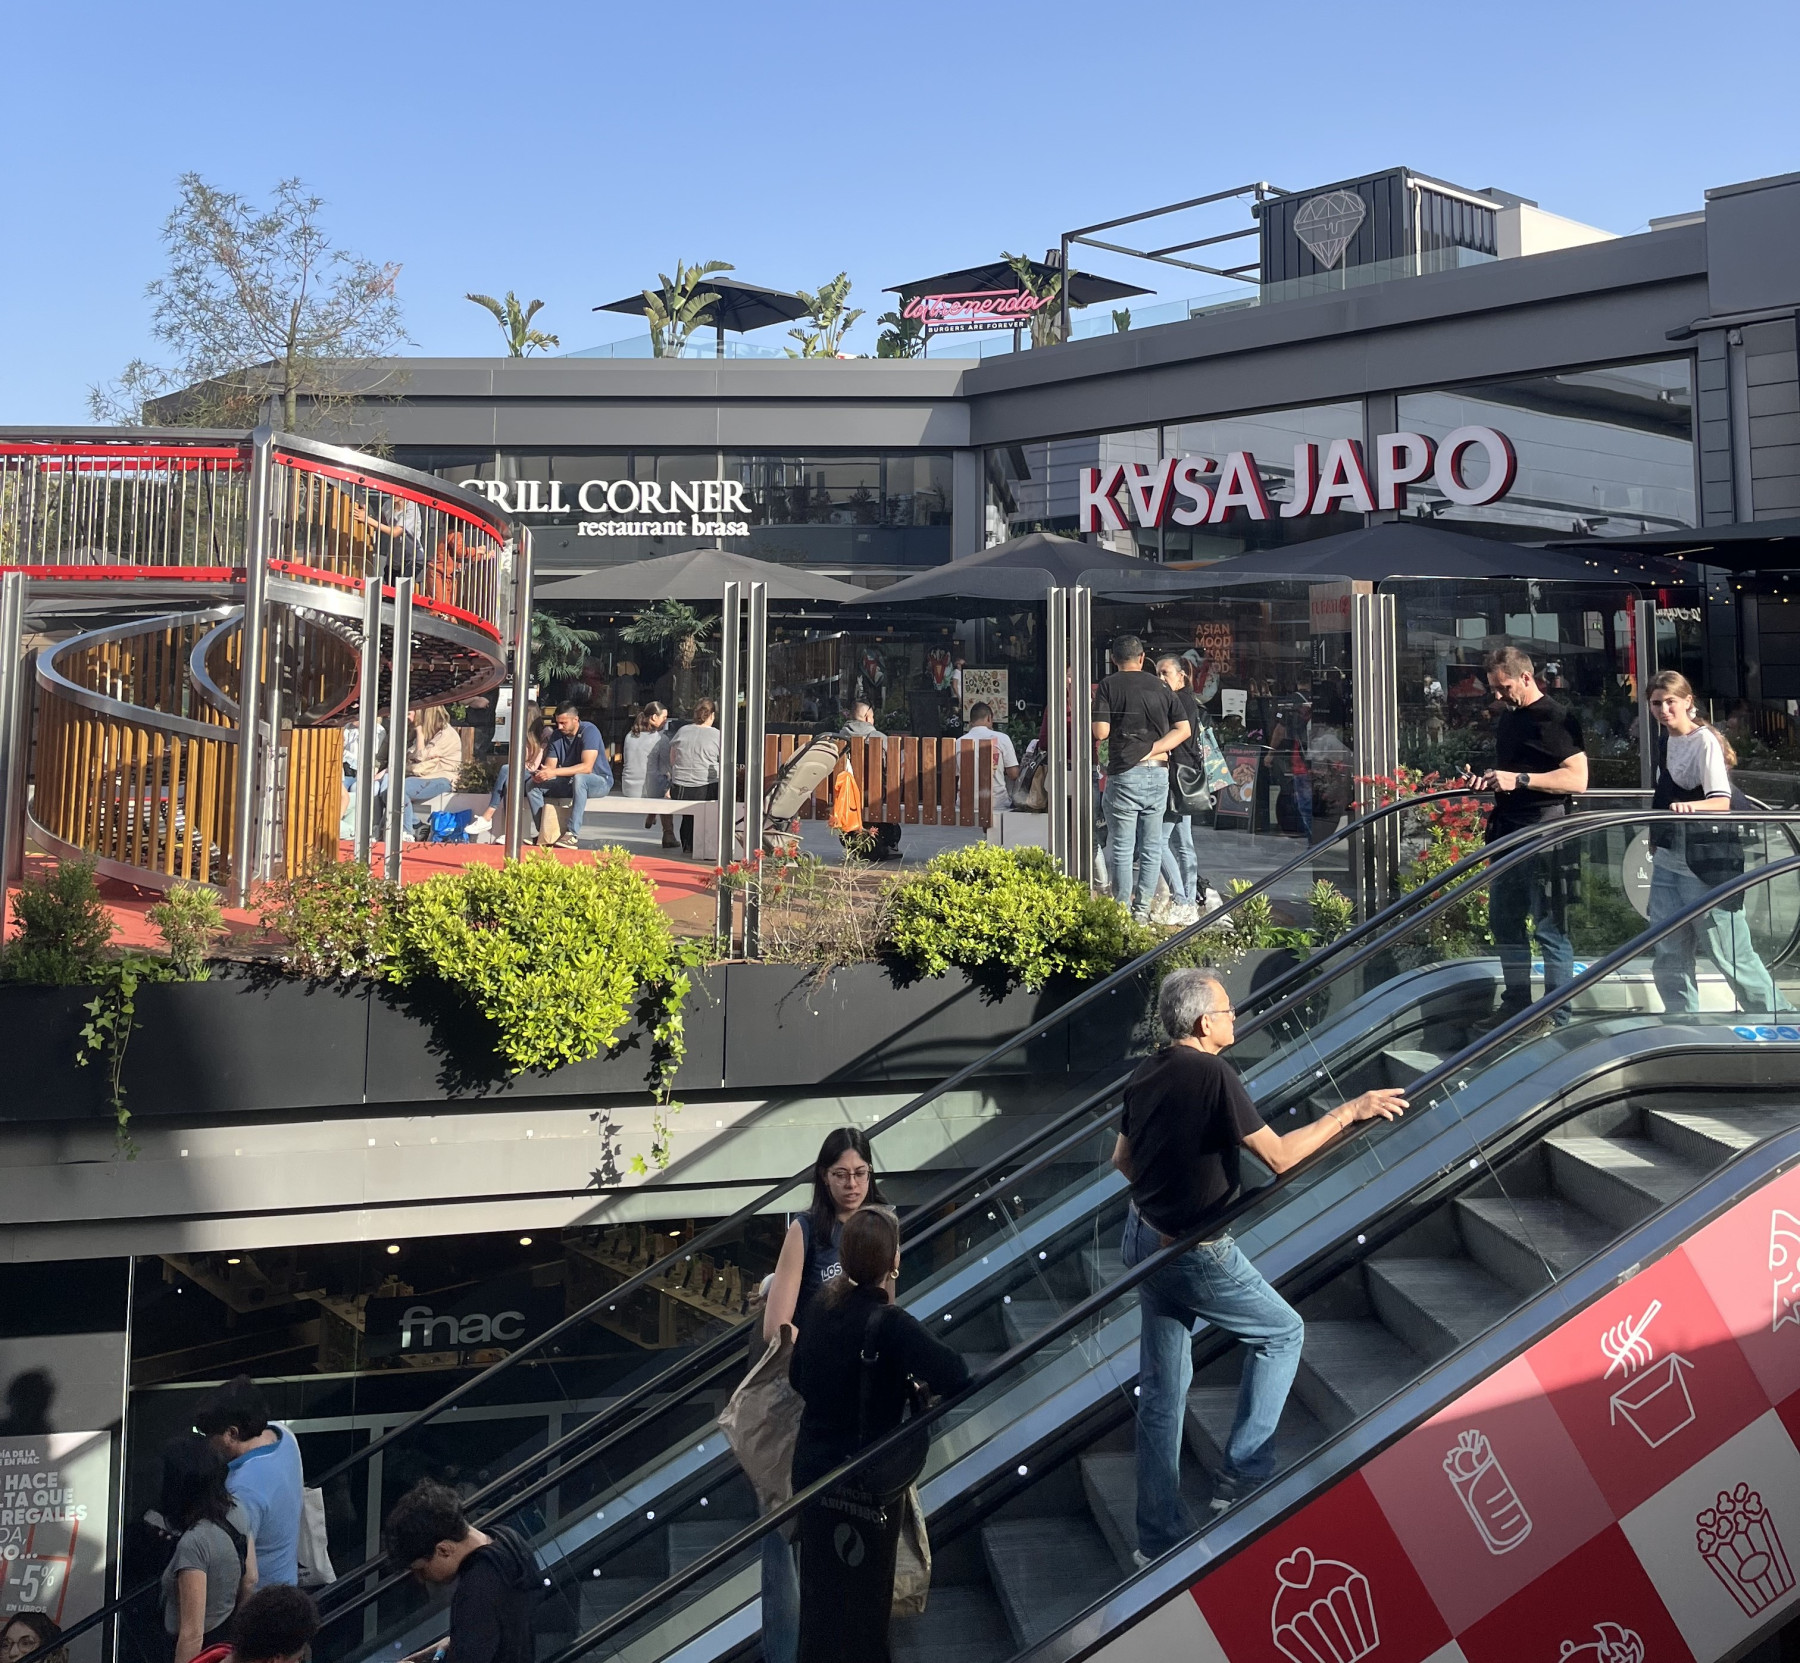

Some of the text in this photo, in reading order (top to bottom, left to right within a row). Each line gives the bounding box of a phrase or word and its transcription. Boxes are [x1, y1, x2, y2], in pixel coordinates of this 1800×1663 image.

[928, 325, 965, 333] BURGERS
[986, 321, 1024, 329] FOREVER
[1279, 425, 1518, 519] JAPO
[578, 479, 752, 514] CORNER
[577, 513, 750, 536] restaurant brasa
[1195, 623, 1231, 635] ASIAN
[1195, 636, 1232, 648] MOOD
[820, 1262, 843, 1282] LOS
[398, 1305, 526, 1348] fnac
[12, 1449, 24, 1458] DE
[25, 1449, 36, 1457] LA
[16, 1457, 40, 1465] FNAC
[5, 1472, 58, 1491] HACE
[33, 1488, 74, 1506] QUE
[2, 1505, 88, 1526] REGALES
[9, 1564, 55, 1603] -5%
[6, 1604, 47, 1613] EN LIBROS
